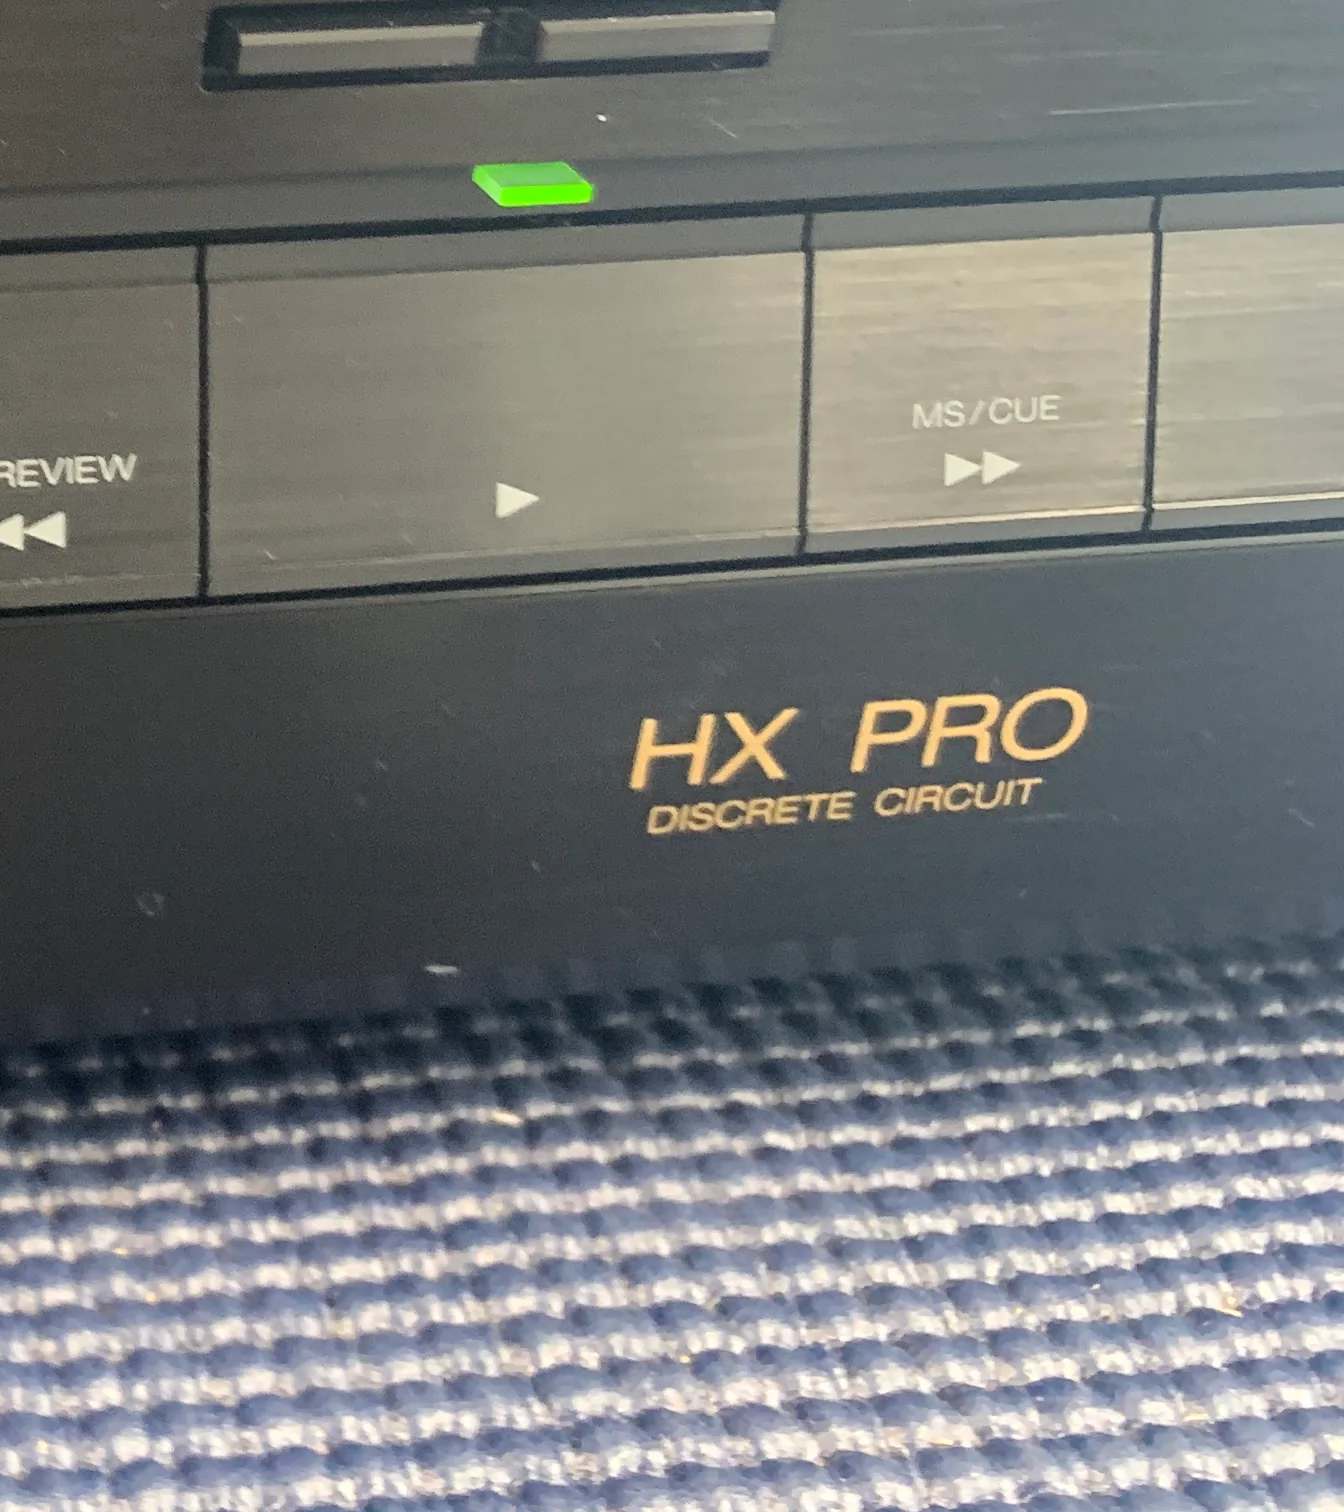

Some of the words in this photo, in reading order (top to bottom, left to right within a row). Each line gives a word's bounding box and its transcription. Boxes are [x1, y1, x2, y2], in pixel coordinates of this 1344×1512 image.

[629, 707, 799, 790] HX
[850, 687, 1089, 773] PRO
[647, 791, 857, 835] DISCRETE
[874, 777, 1043, 817] CIRCUIT
